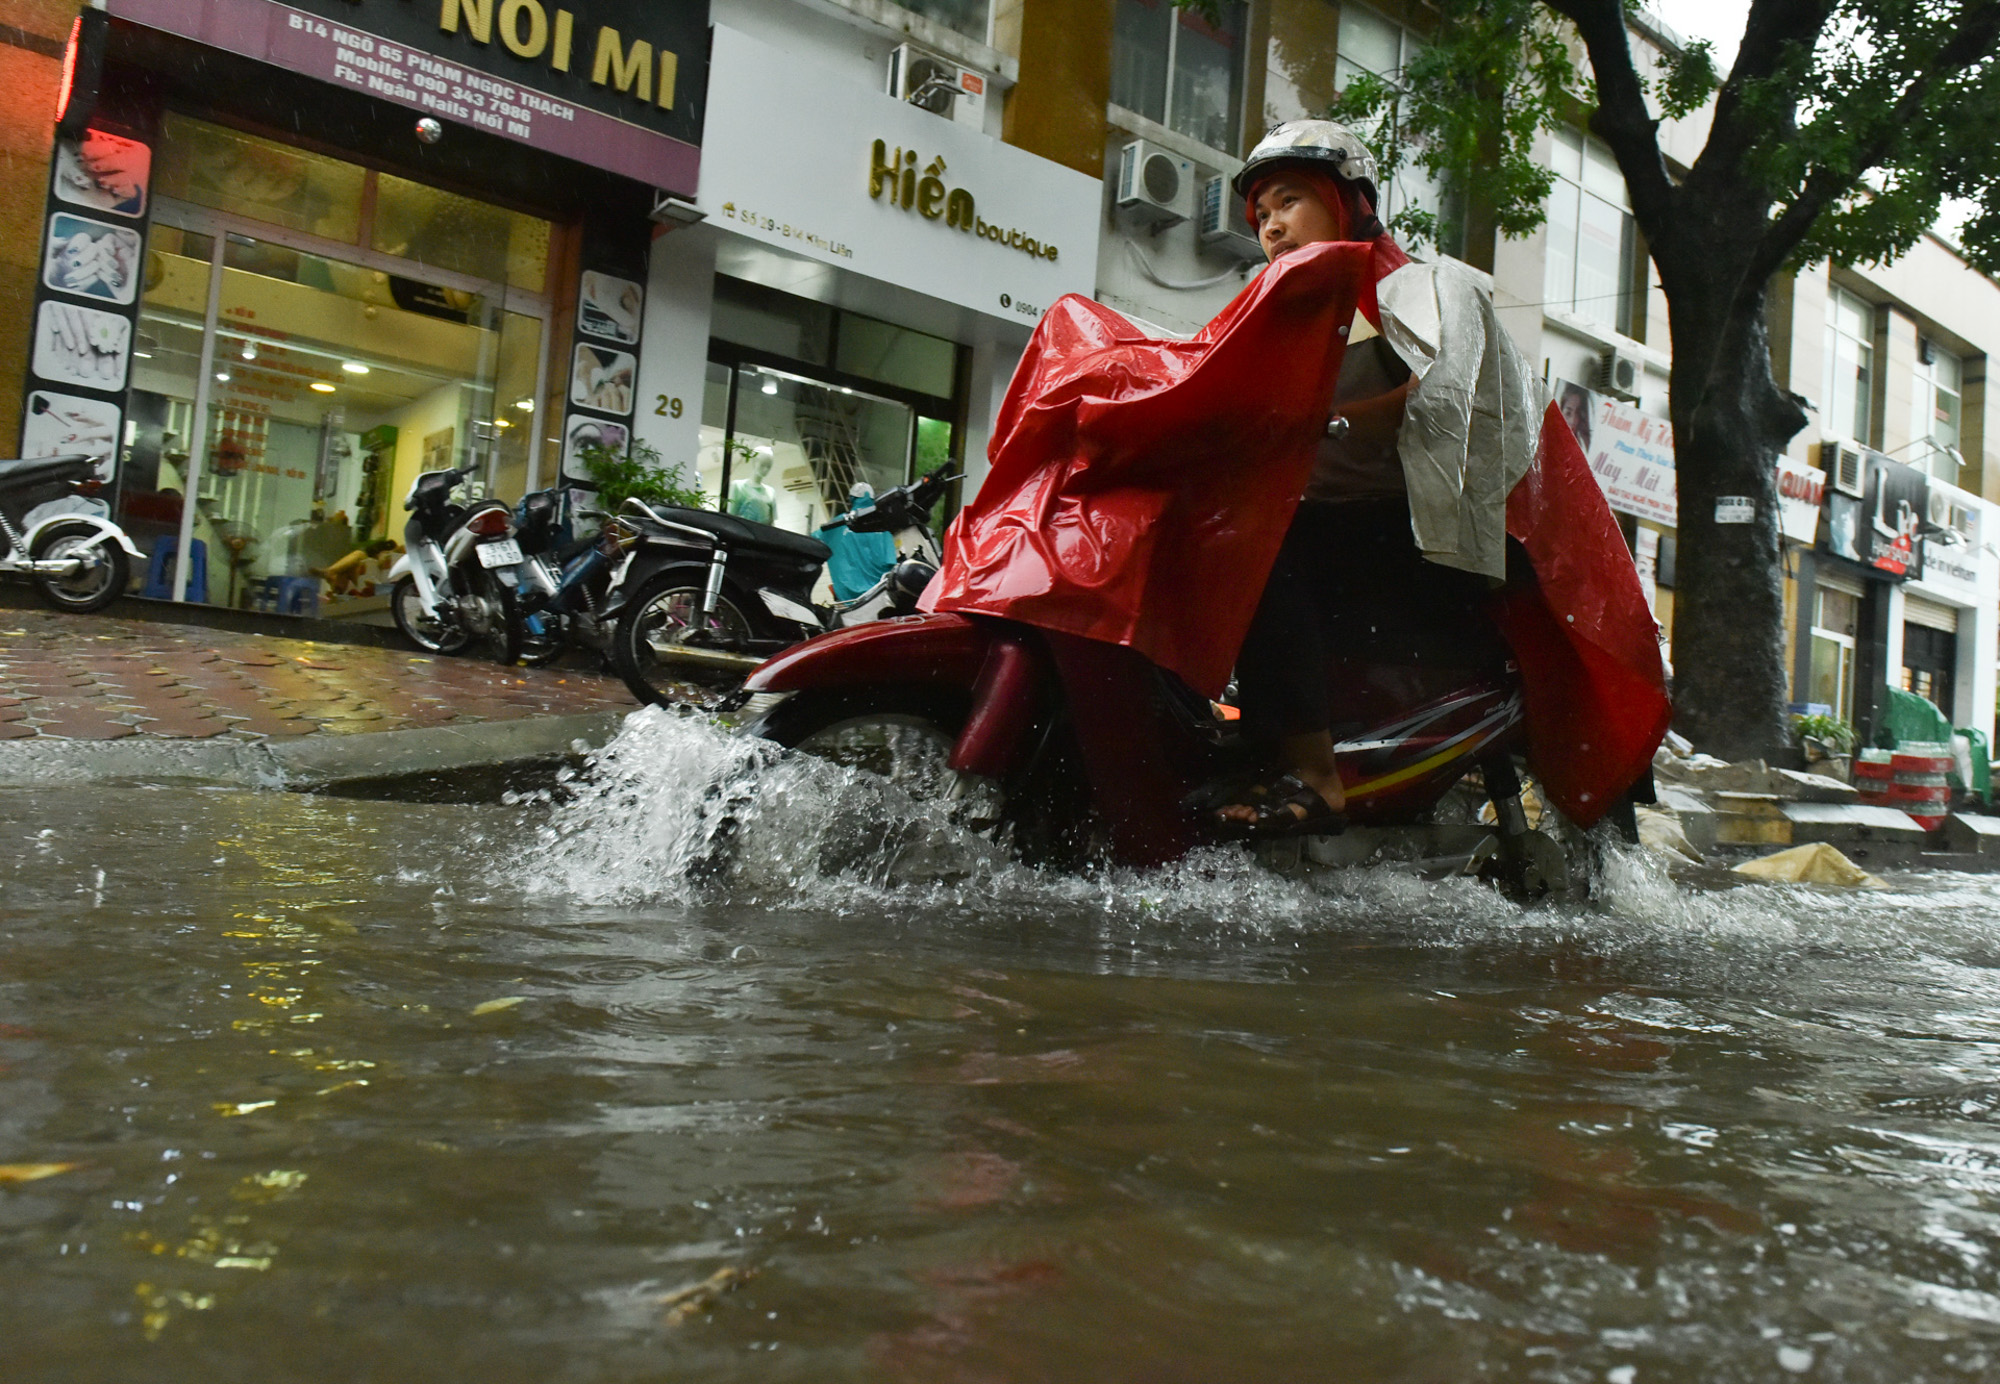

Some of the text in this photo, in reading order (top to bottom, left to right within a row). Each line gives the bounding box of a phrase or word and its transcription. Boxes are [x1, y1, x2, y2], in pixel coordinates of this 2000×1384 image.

[288, 13, 574, 121] B14 NGÕ 65 PHẠM NGỌC THẠCH
[334, 64, 530, 139] Fb: Ngân Nails Nối Mi
[336, 47, 532, 123] Mobile: 090 343 7986
[591, 26, 677, 111] MI
[869, 138, 1059, 262] Hiền boutique
[1015, 301, 1038, 318] 0904
[655, 394, 683, 419] 29
